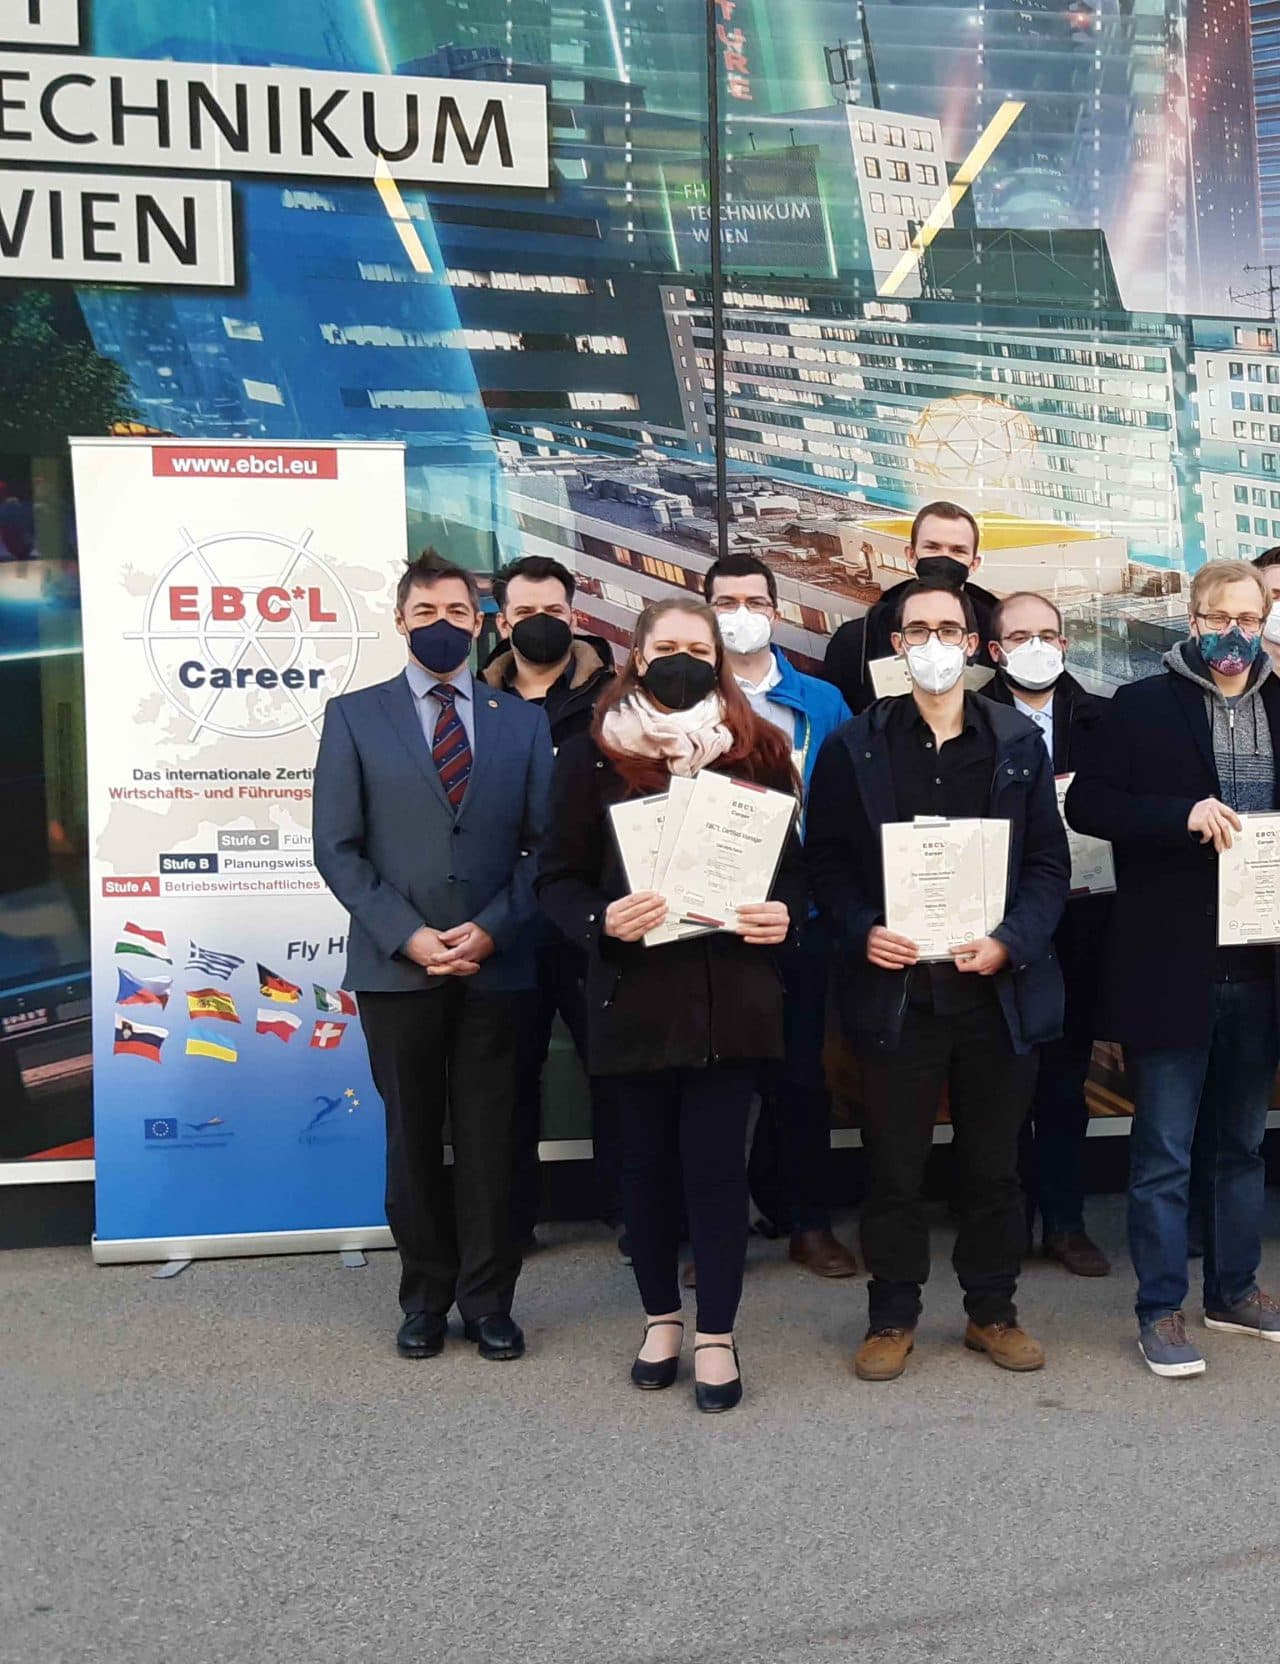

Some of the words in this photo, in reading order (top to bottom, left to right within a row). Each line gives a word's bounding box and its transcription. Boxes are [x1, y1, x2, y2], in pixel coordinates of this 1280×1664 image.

[684, 184, 706, 199] FH
[172, 454, 319, 475] www.ebcl.eu
[178, 660, 326, 689] Career
[132, 767, 162, 781] Das
[165, 767, 271, 781] internationale
[109, 786, 199, 800] Wirtschafts-
[204, 786, 234, 799] und
[220, 834, 257, 847] Stufe
[259, 833, 271, 846] C
[163, 857, 196, 870] Stufe
[199, 857, 210, 870] B
[105, 880, 139, 893] Stufe
[141, 880, 152, 893] A
[165, 879, 321, 892] Betriebswirtschaftliches
[287, 940, 320, 962] Fly
